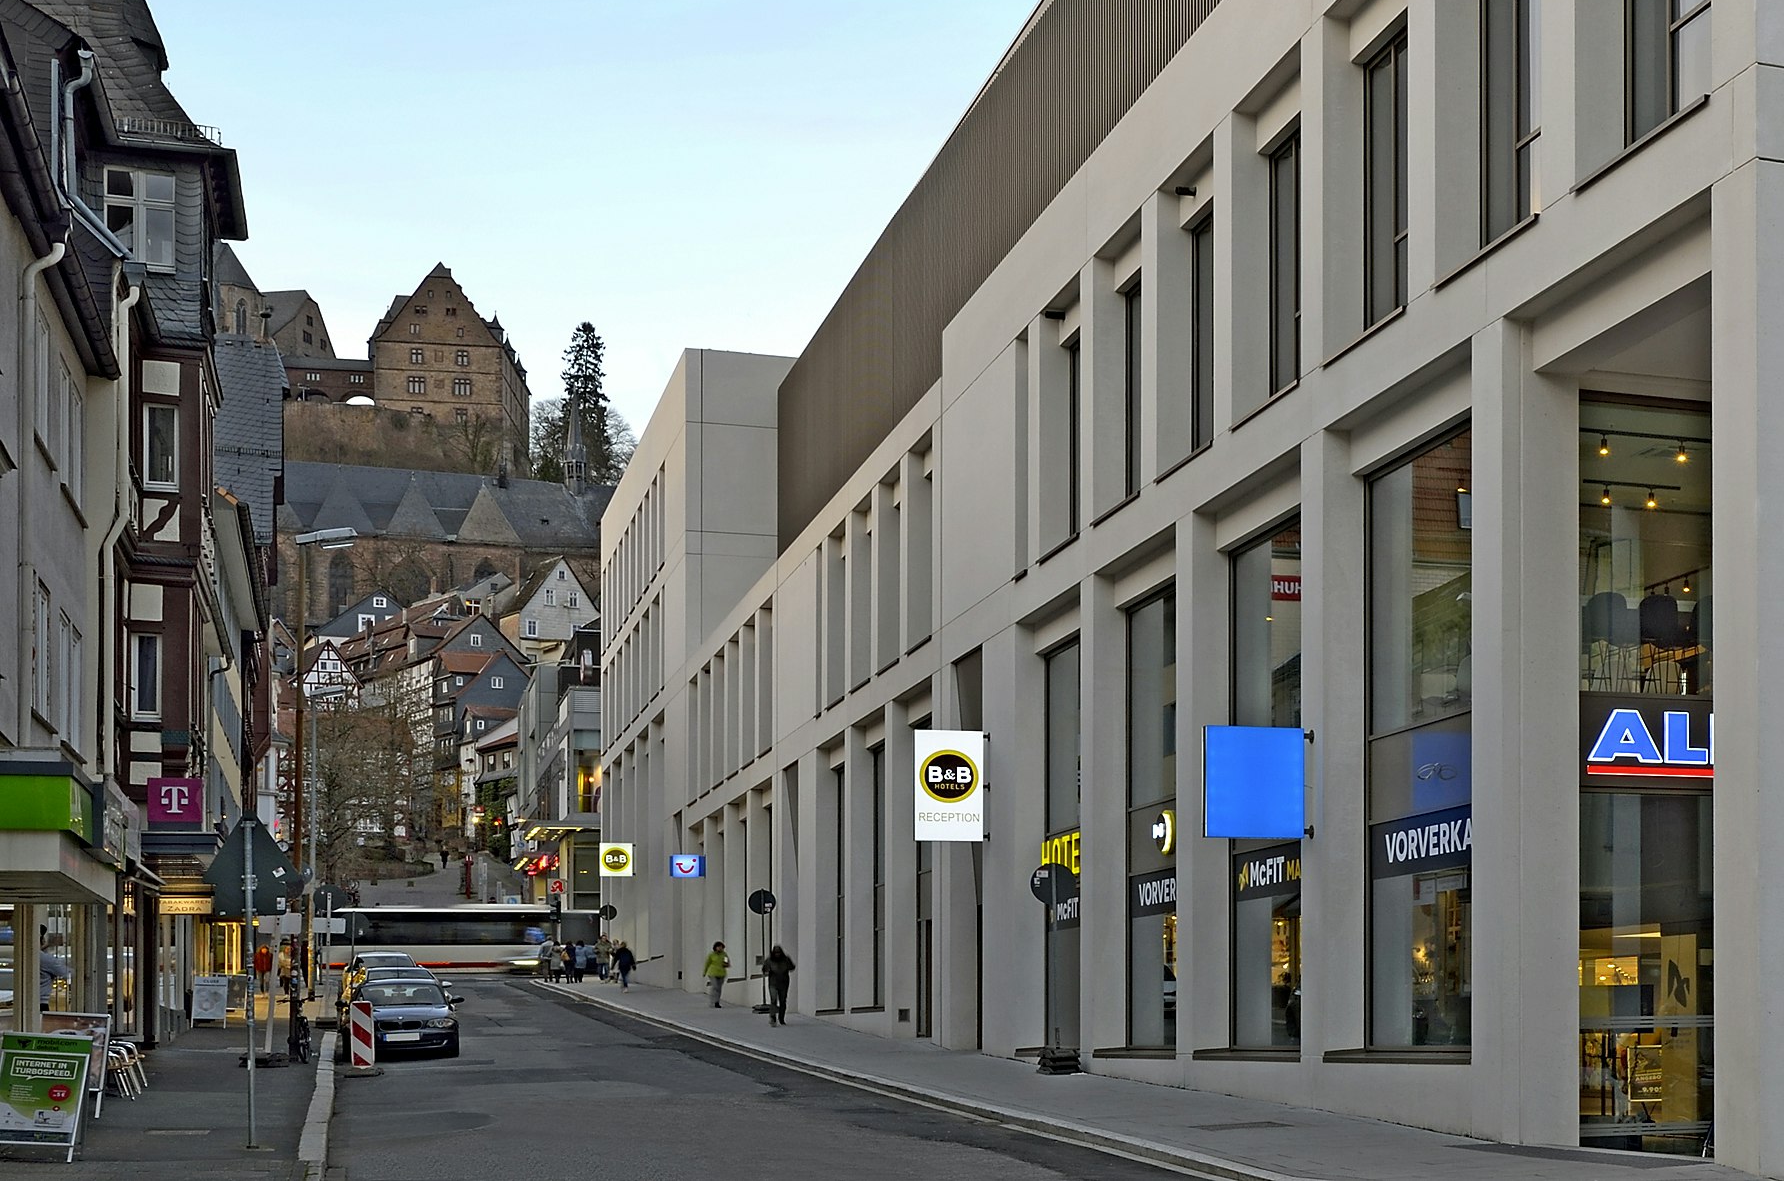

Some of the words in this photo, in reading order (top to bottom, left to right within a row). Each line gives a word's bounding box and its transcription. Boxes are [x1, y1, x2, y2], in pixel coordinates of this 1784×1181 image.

[1587, 708, 1715, 765] AL
[928, 765, 972, 784] B&B
[918, 812, 980, 823] RECEPTION
[1385, 818, 1472, 864] VORVERKA
[605, 854, 627, 863] B&B
[1250, 856, 1285, 888] McFIT
[1138, 877, 1176, 907] VORVER
[15, 1067, 72, 1077] TURBOSPEED.
[16, 1059, 57, 1069] INTERNET
